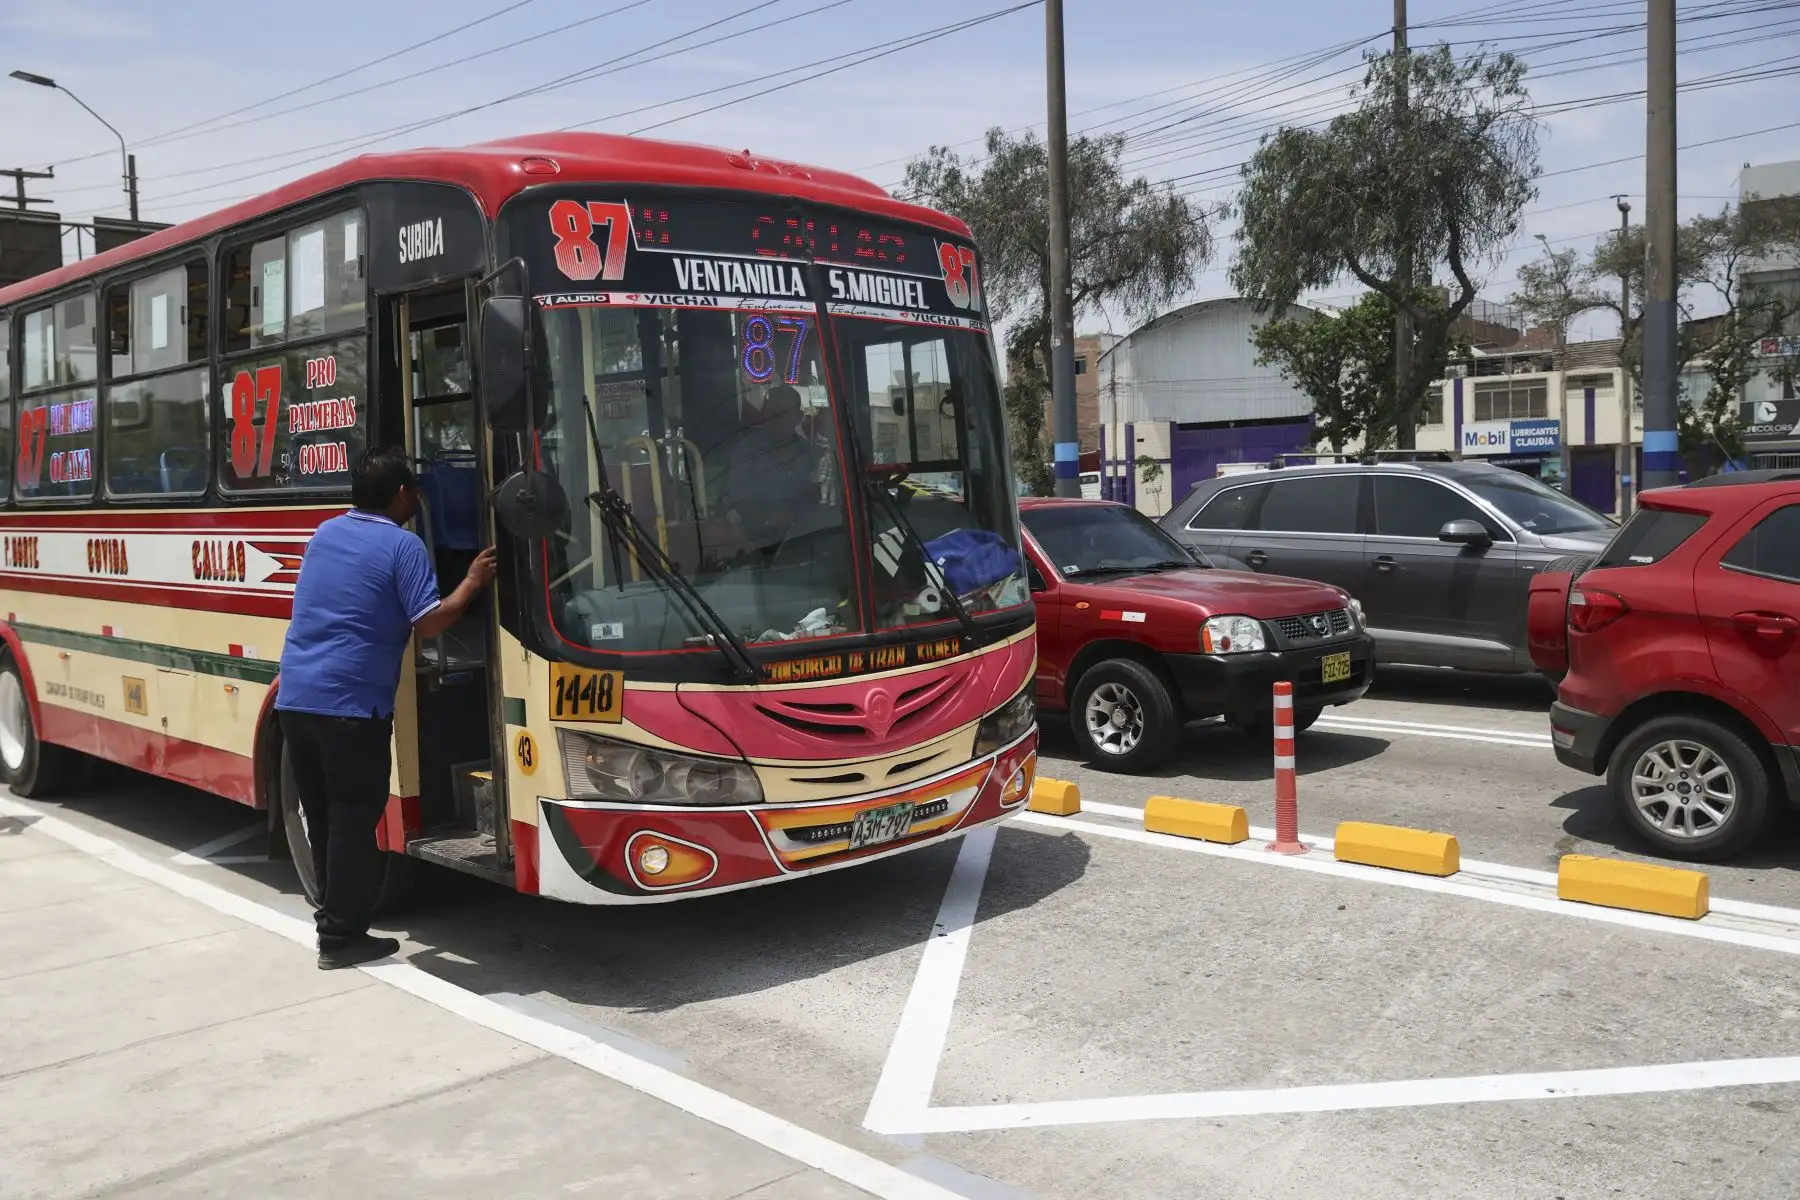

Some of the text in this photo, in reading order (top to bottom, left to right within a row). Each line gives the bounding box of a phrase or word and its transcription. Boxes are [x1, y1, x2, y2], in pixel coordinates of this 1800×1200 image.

[399, 216, 444, 264] SUBIDA
[549, 200, 630, 281] 87
[672, 257, 806, 298] VENTANILLA
[829, 269, 930, 310] S.MIGUEL
[938, 242, 981, 313] 87
[555, 294, 607, 305] AUDIO
[644, 294, 719, 307] YUCHAI
[911, 313, 960, 327] YUCHAI
[741, 314, 808, 384] 87
[306, 355, 337, 389] PRO
[231, 364, 281, 479] 87
[288, 396, 356, 433] PALMERAS
[1511, 427, 1559, 437] LUBRICANTES
[17, 405, 46, 490] 87
[1465, 430, 1505, 446] Mobil
[1515, 437, 1554, 447] CLAUDIA
[50, 448, 92, 483] OLAYA
[298, 441, 348, 475] COVIDA
[87, 539, 128, 575] COVIDA
[192, 540, 246, 582] CALLAO
[916, 638, 960, 660] KILMER
[556, 673, 614, 716] 1448
[518, 735, 532, 767] 43
[854, 814, 911, 843] A3M-797
